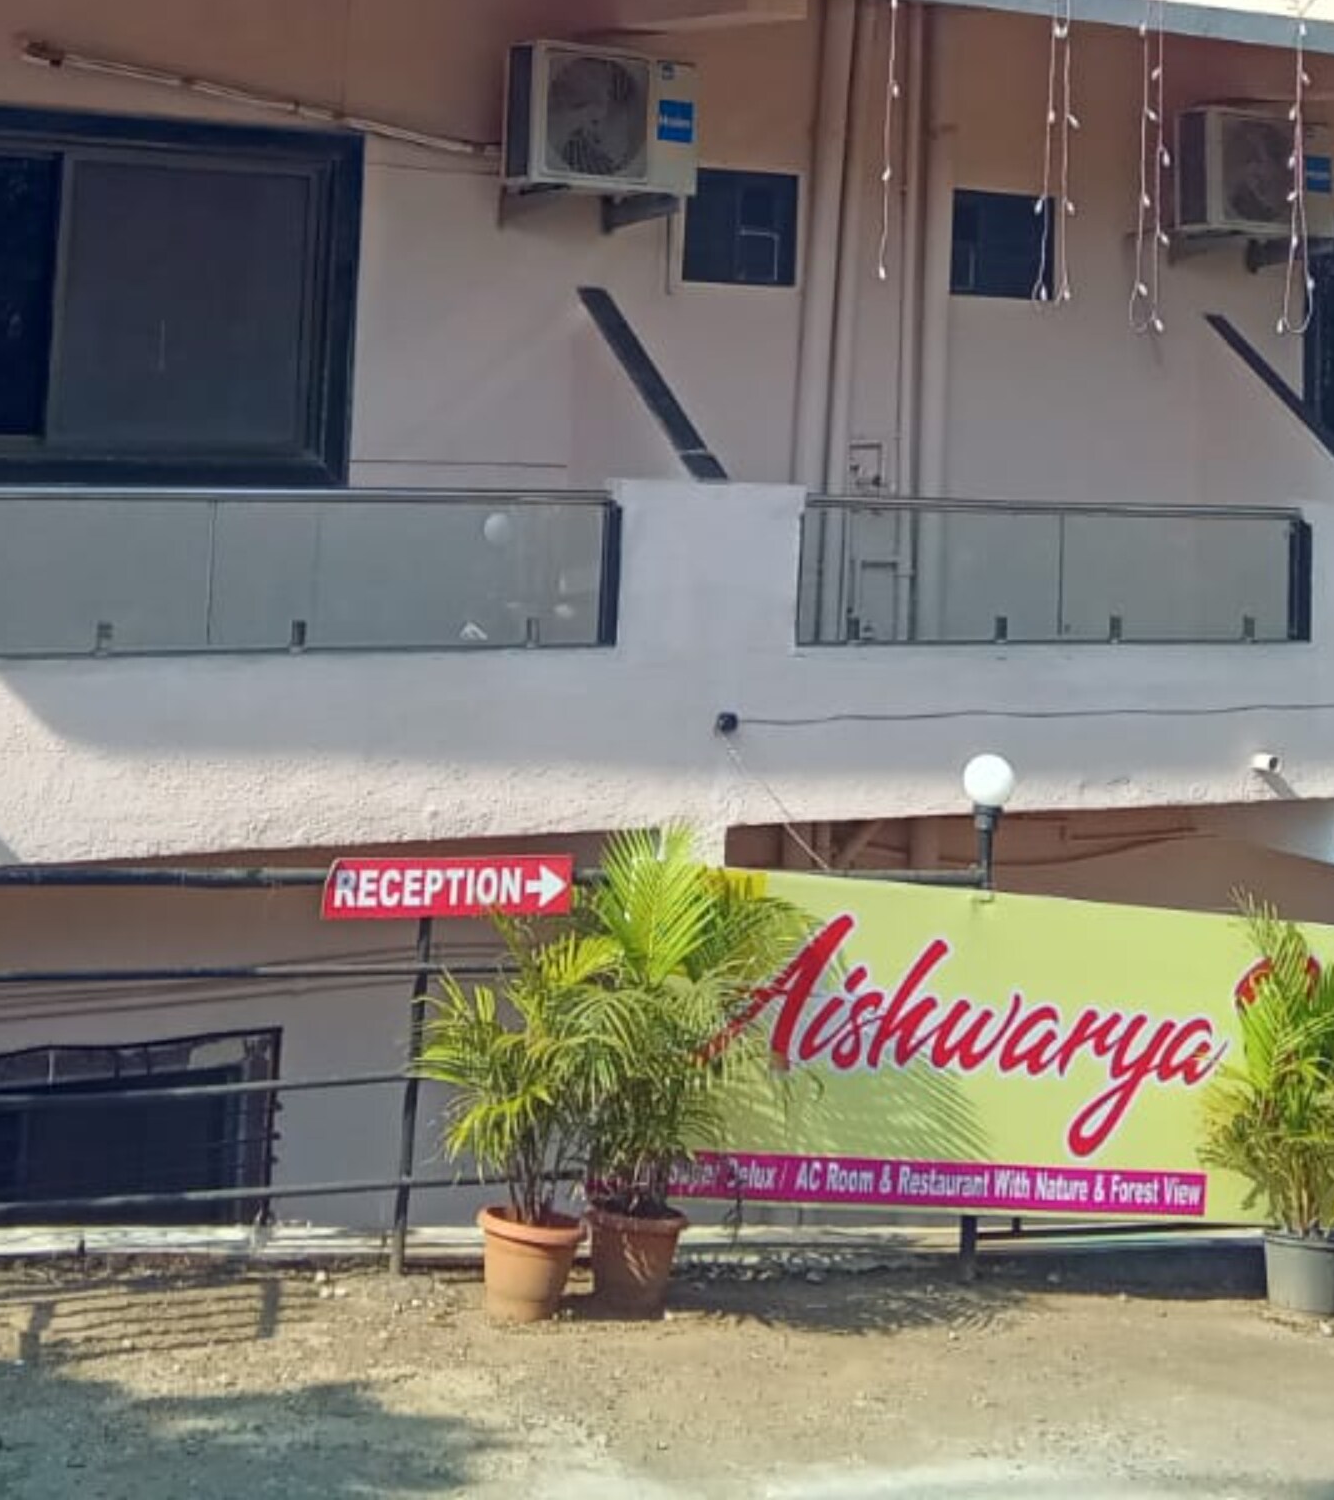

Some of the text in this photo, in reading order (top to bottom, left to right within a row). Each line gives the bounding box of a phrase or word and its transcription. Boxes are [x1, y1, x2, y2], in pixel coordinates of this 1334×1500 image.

[334, 866, 523, 909] RECEPTION
[693, 913, 1228, 1156] Aishwarya
[795, 1161, 822, 1192] AC
[826, 1161, 875, 1194] Room
[879, 1164, 893, 1194] &
[897, 1165, 990, 1199] Restaurant
[994, 1169, 1031, 1200] With
[1034, 1171, 1088, 1202] Nature
[1093, 1174, 1105, 1202] &
[1109, 1174, 1160, 1205] Forest
[1163, 1176, 1203, 1206] View
